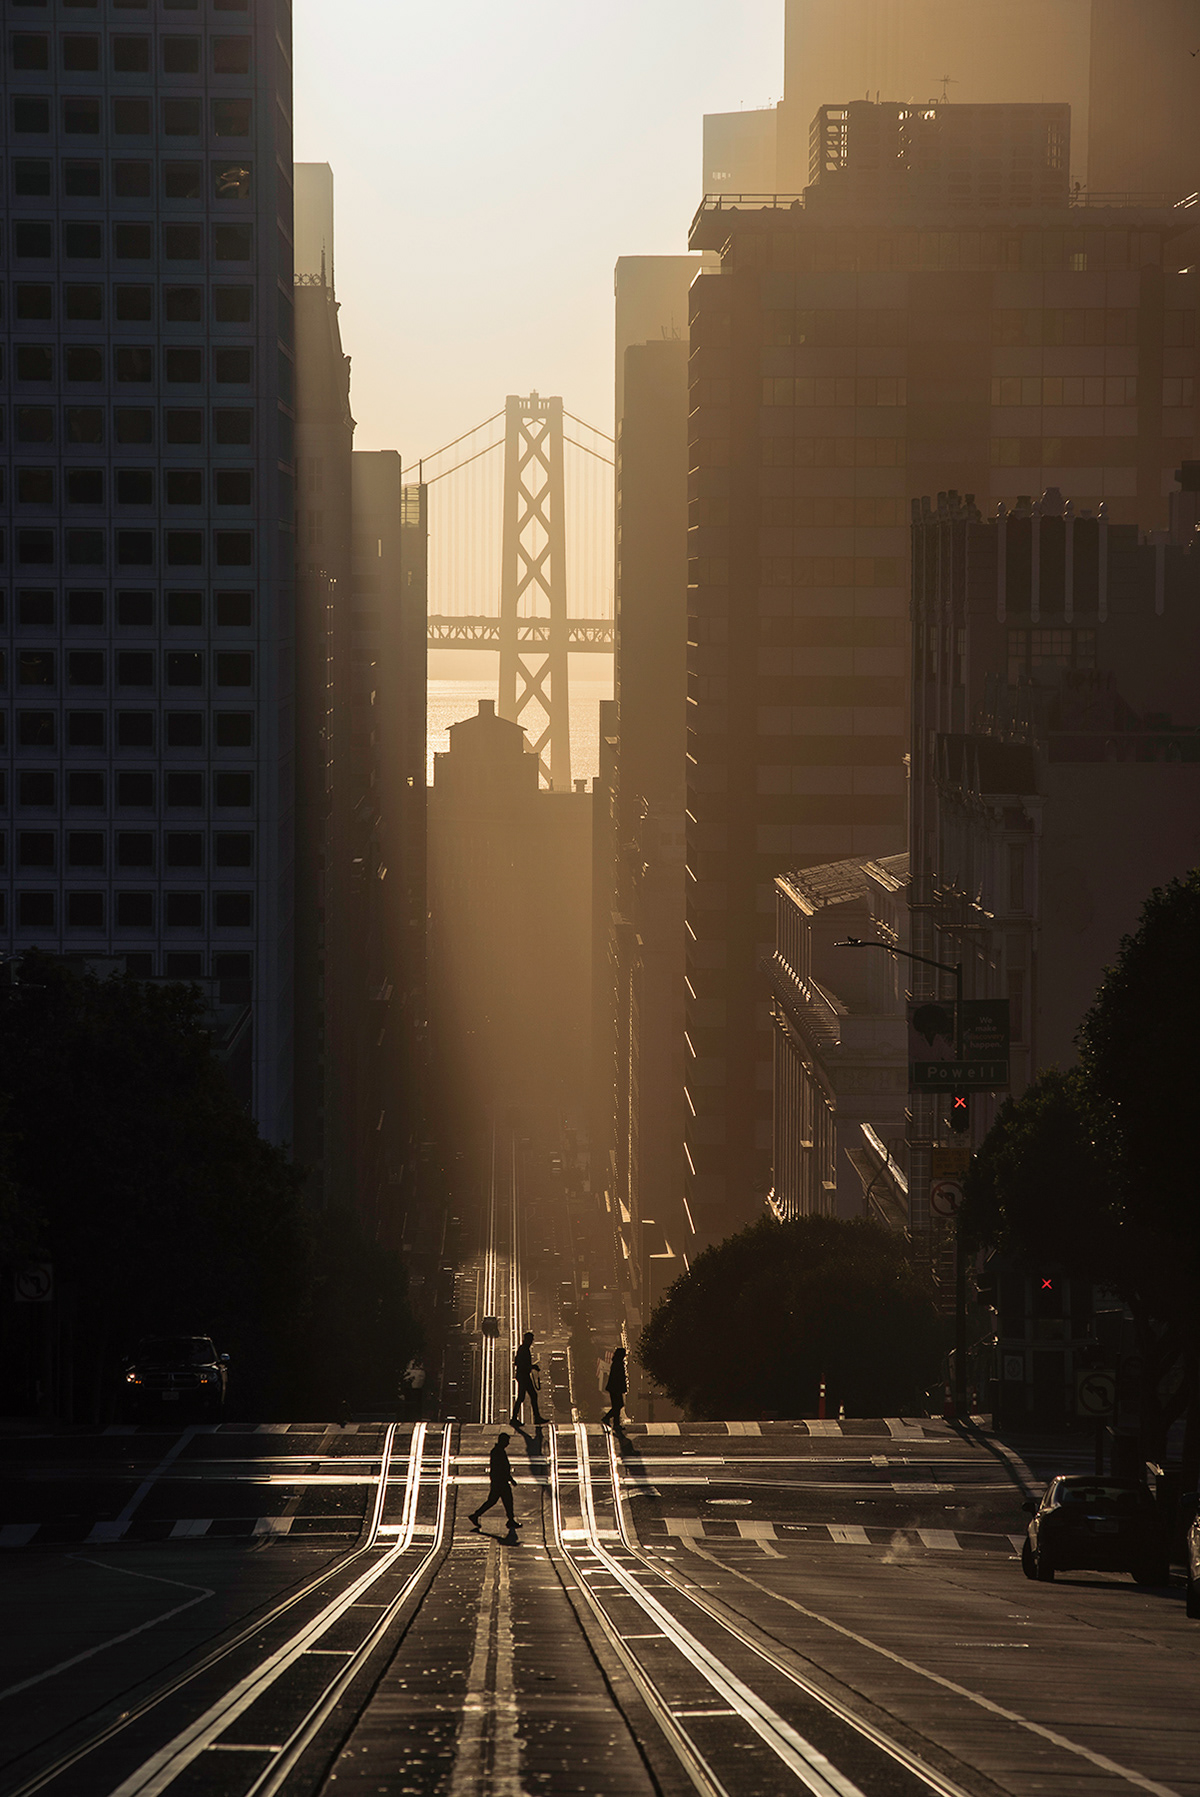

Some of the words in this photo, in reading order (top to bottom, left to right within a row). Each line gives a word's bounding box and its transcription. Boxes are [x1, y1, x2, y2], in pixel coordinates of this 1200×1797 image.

[979, 1016, 993, 1024] We
[975, 1024, 998, 1032] make
[969, 1041, 1002, 1050] happen.
[927, 1066, 994, 1079] Powell
